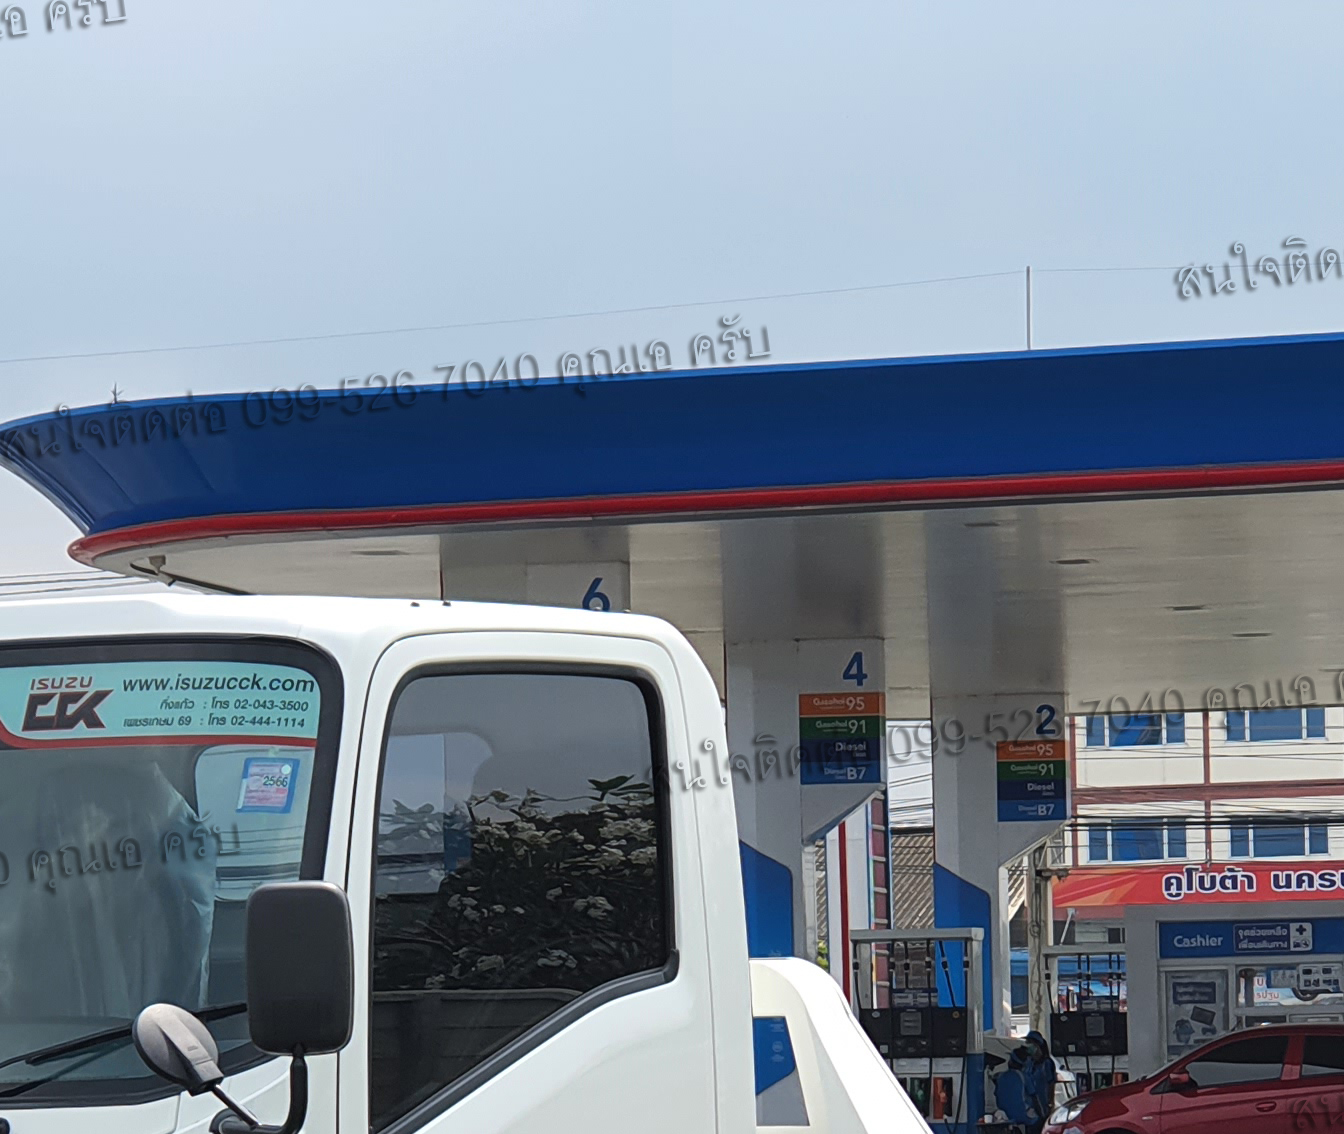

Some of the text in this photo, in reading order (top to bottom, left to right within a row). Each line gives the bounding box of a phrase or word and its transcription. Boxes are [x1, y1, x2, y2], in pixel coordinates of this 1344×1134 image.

[582, 577, 610, 612] 6
[842, 651, 868, 687] 4
[30, 676, 94, 690] ISUZU
[122, 673, 315, 693] www.isuzucck.com
[234, 699, 309, 711] 02-043-3500
[846, 696, 865, 711] 95
[178, 716, 192, 726] 69
[230, 715, 305, 728] 02-444-1114
[1036, 704, 1056, 735] 2
[848, 719, 866, 734] 91
[835, 741, 867, 752] Diesel
[1037, 743, 1054, 756] 95
[847, 766, 867, 780] B7
[1038, 763, 1054, 776] 91
[262, 775, 289, 787] 2566
[1026, 781, 1055, 791] Diesel
[1037, 803, 1055, 816] B7
[1162, 865, 1256, 900] คูโบต้า
[1174, 934, 1224, 947] Cashier
